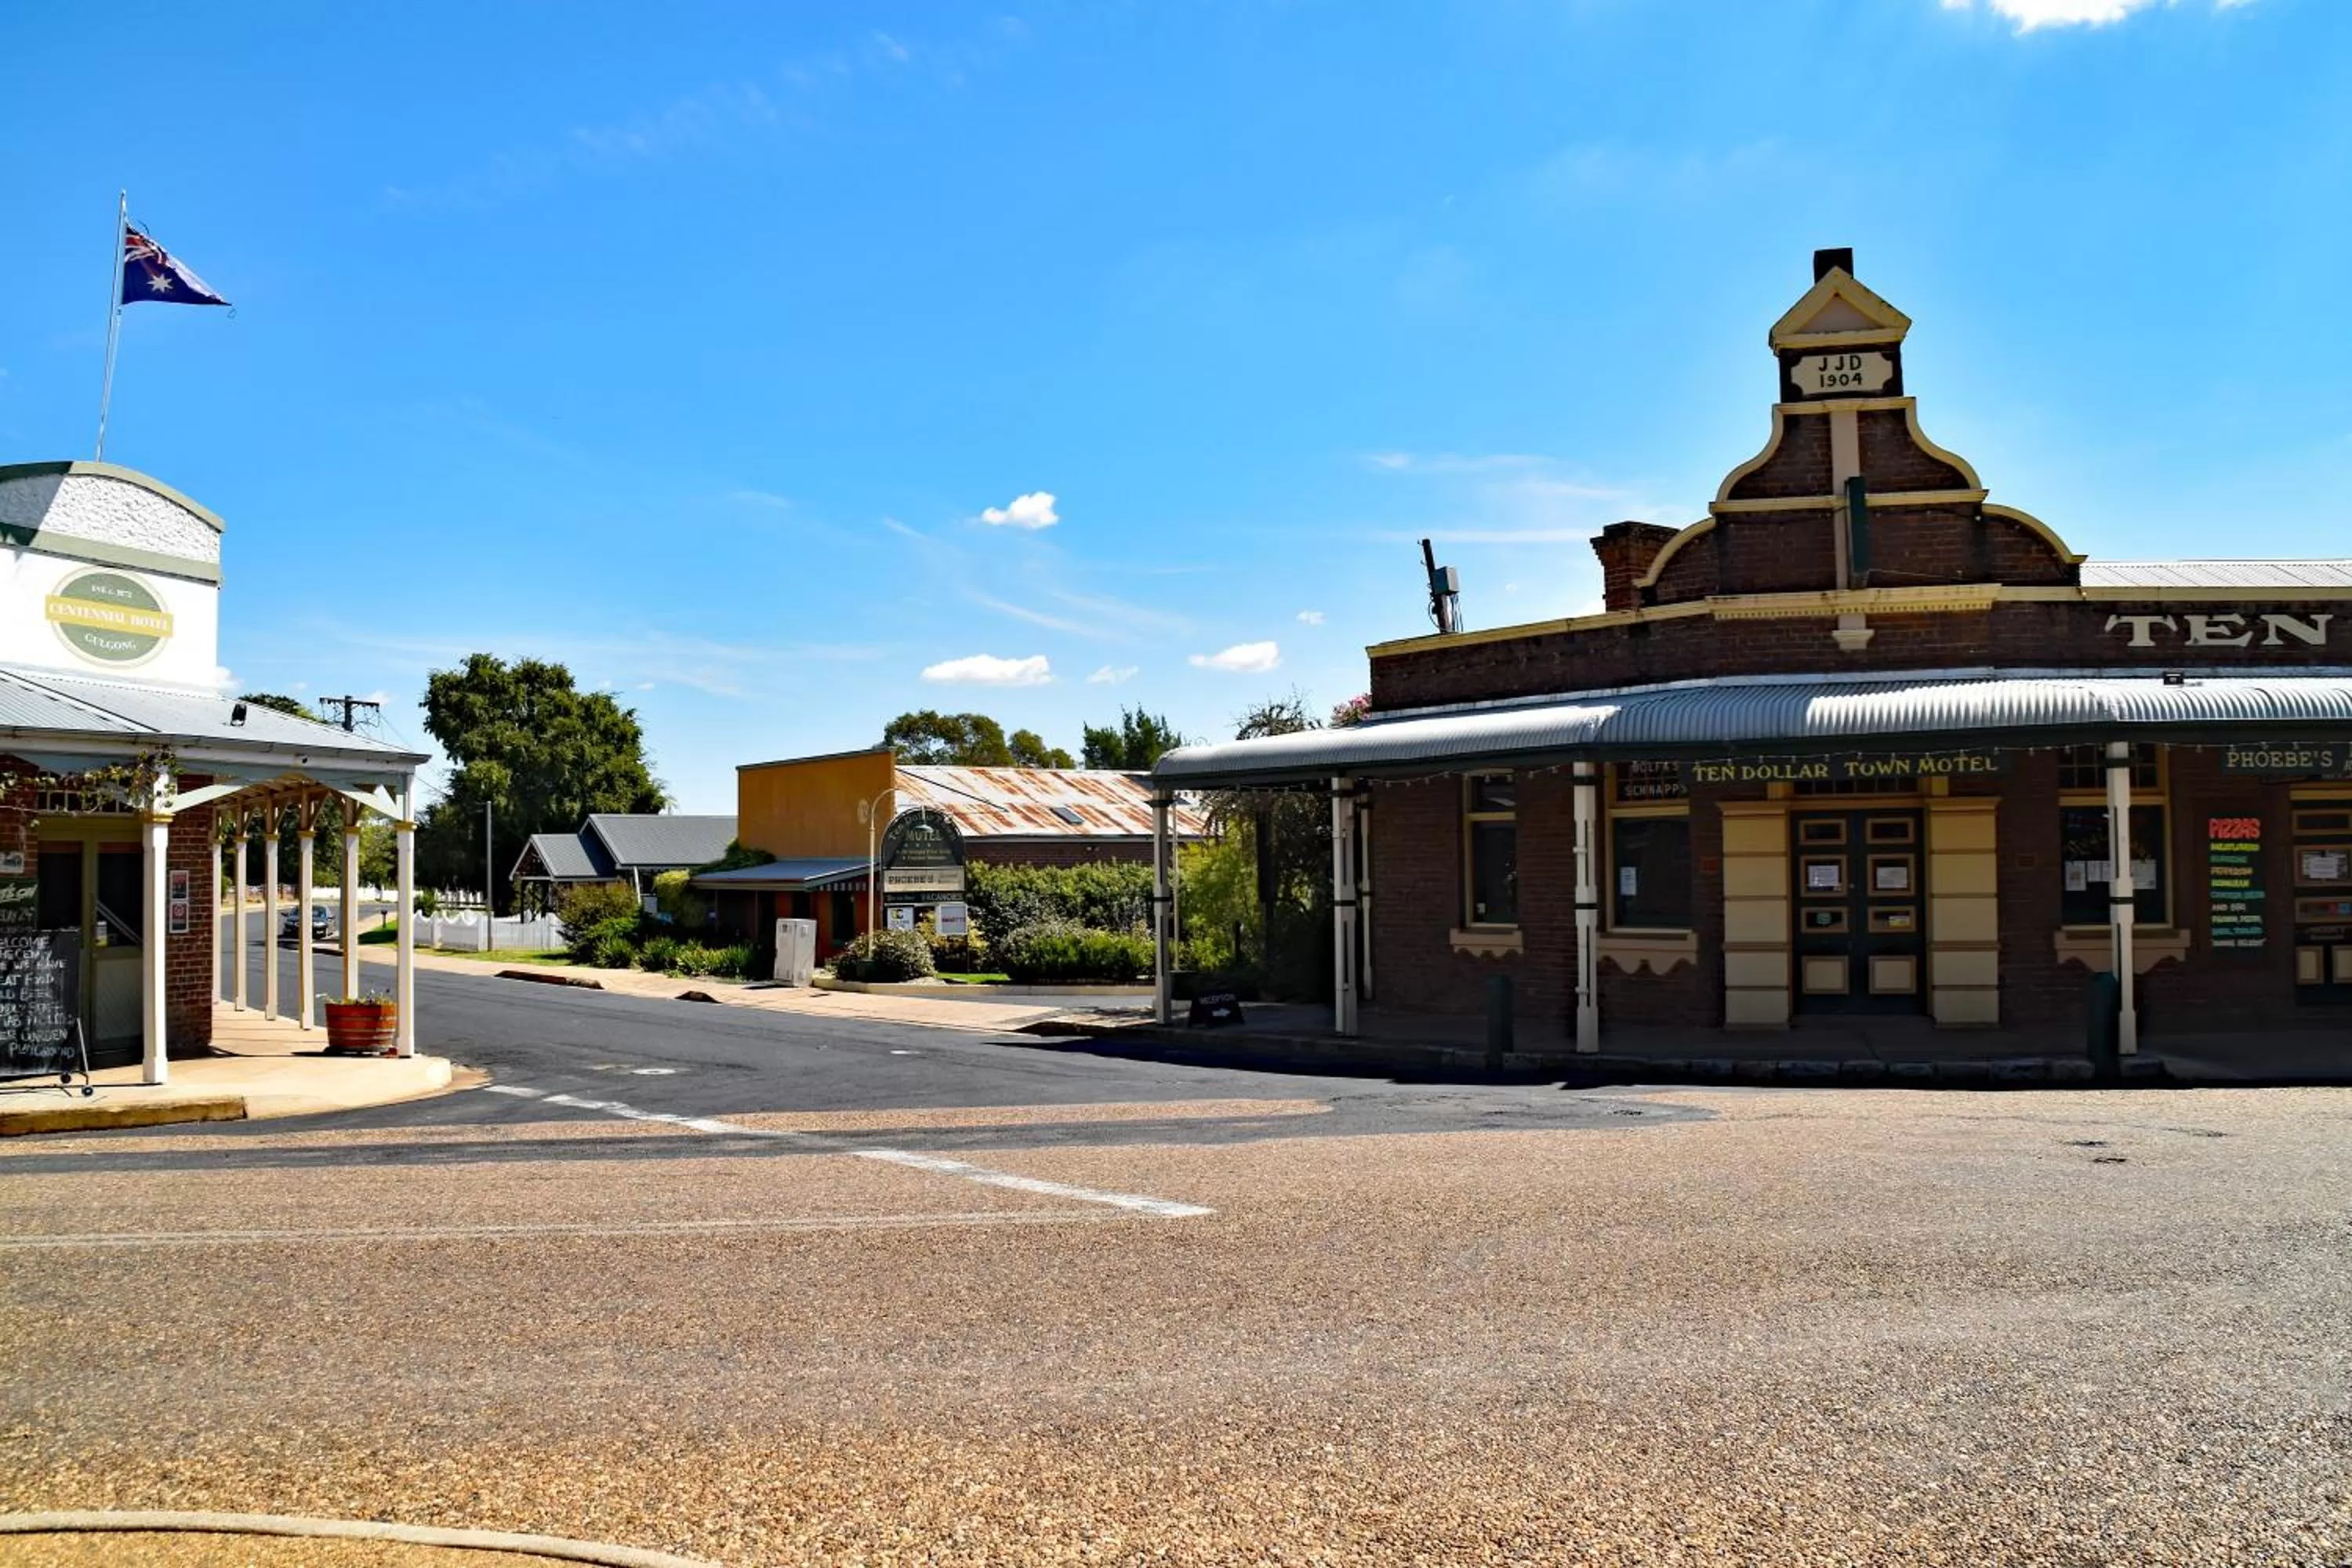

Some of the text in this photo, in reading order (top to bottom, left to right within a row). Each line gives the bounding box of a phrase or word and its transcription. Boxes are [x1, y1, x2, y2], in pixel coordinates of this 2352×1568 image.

[1820, 372, 1863, 387] 1904
[49, 603, 168, 631] CENTENNIAL HOTEL
[2104, 612, 2334, 647] TEN
[85, 633, 136, 650] GULGONG
[1693, 756, 1998, 782] TEN DOLLAR TOWN MOTEL
[2227, 750, 2333, 768] PHOEBE'S
